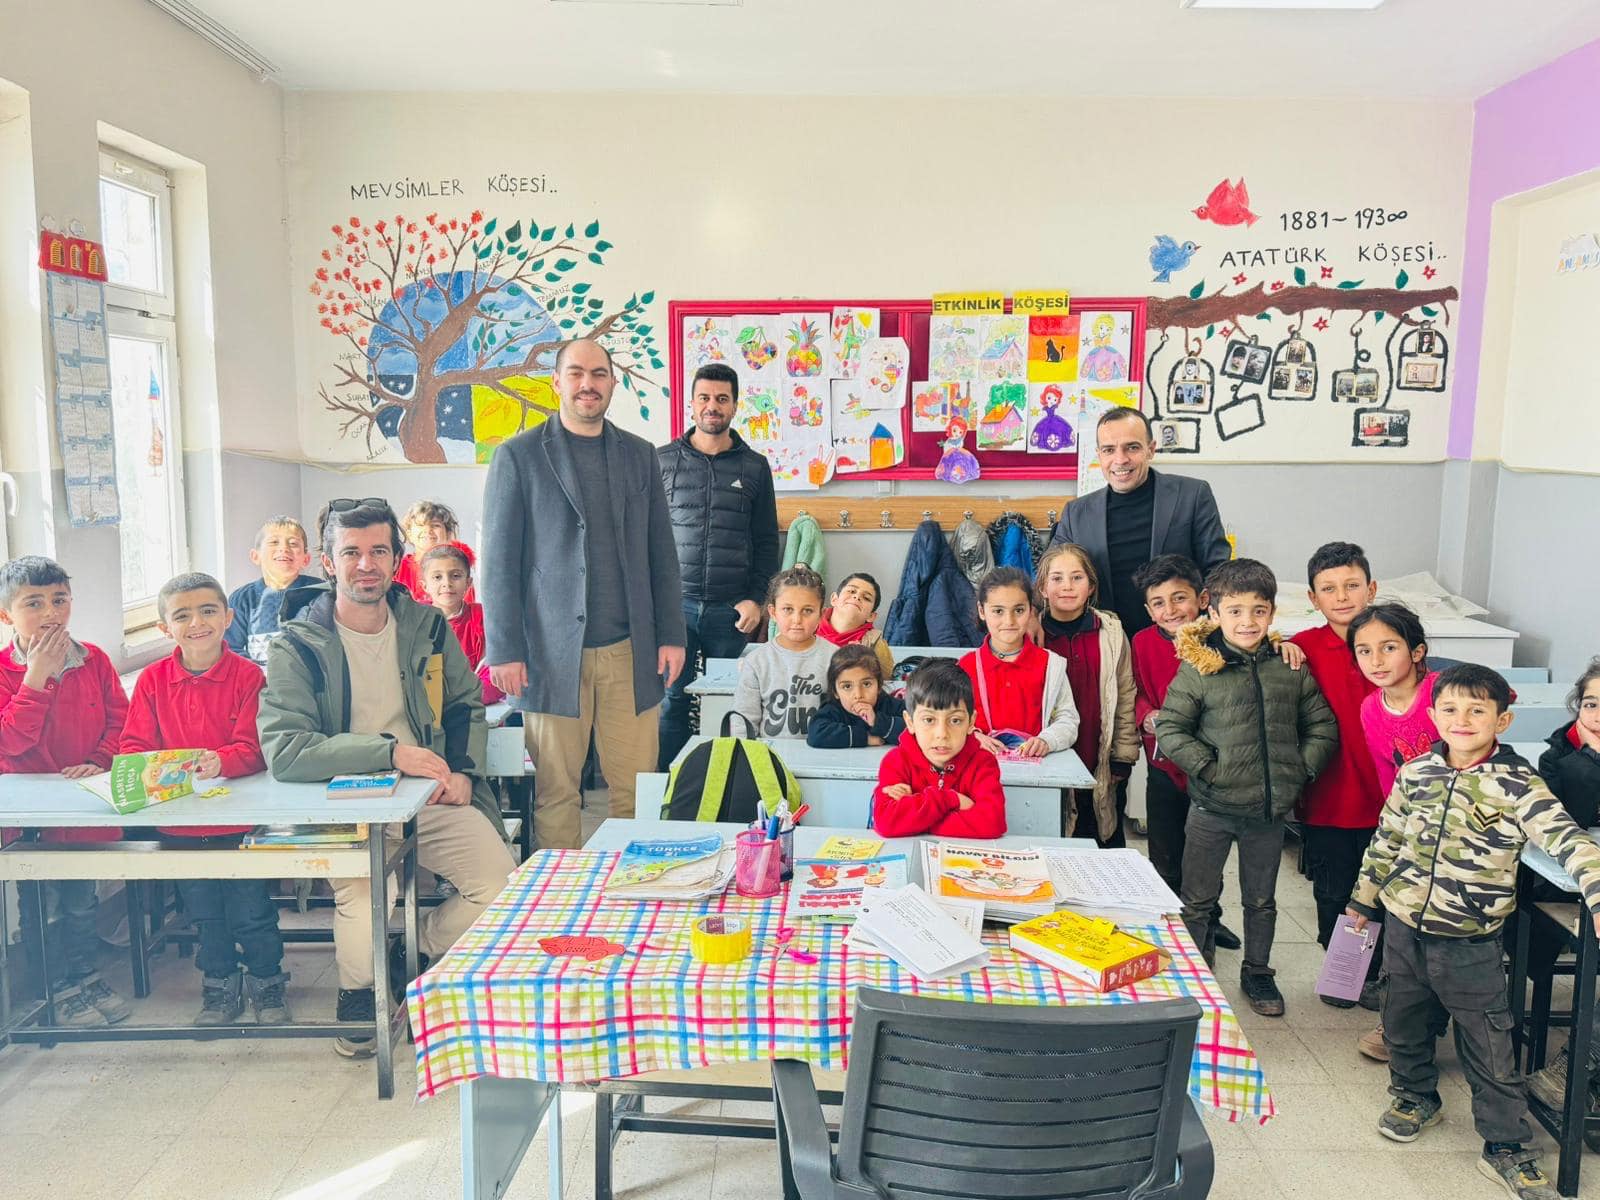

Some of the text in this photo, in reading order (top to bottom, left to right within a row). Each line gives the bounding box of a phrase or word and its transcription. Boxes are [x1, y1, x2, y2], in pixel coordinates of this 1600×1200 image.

[350, 176, 464, 200] MEVSİMLER
[1219, 246, 1327, 268] ATATÜRK
[933, 294, 1069, 312] ETKİNLİK KÖŞESİ
[789, 673, 823, 696] The
[764, 689, 818, 737] Gir
[126, 767, 137, 793] HOCA
[946, 848, 1040, 862] HAYAT BİLGİSİ
